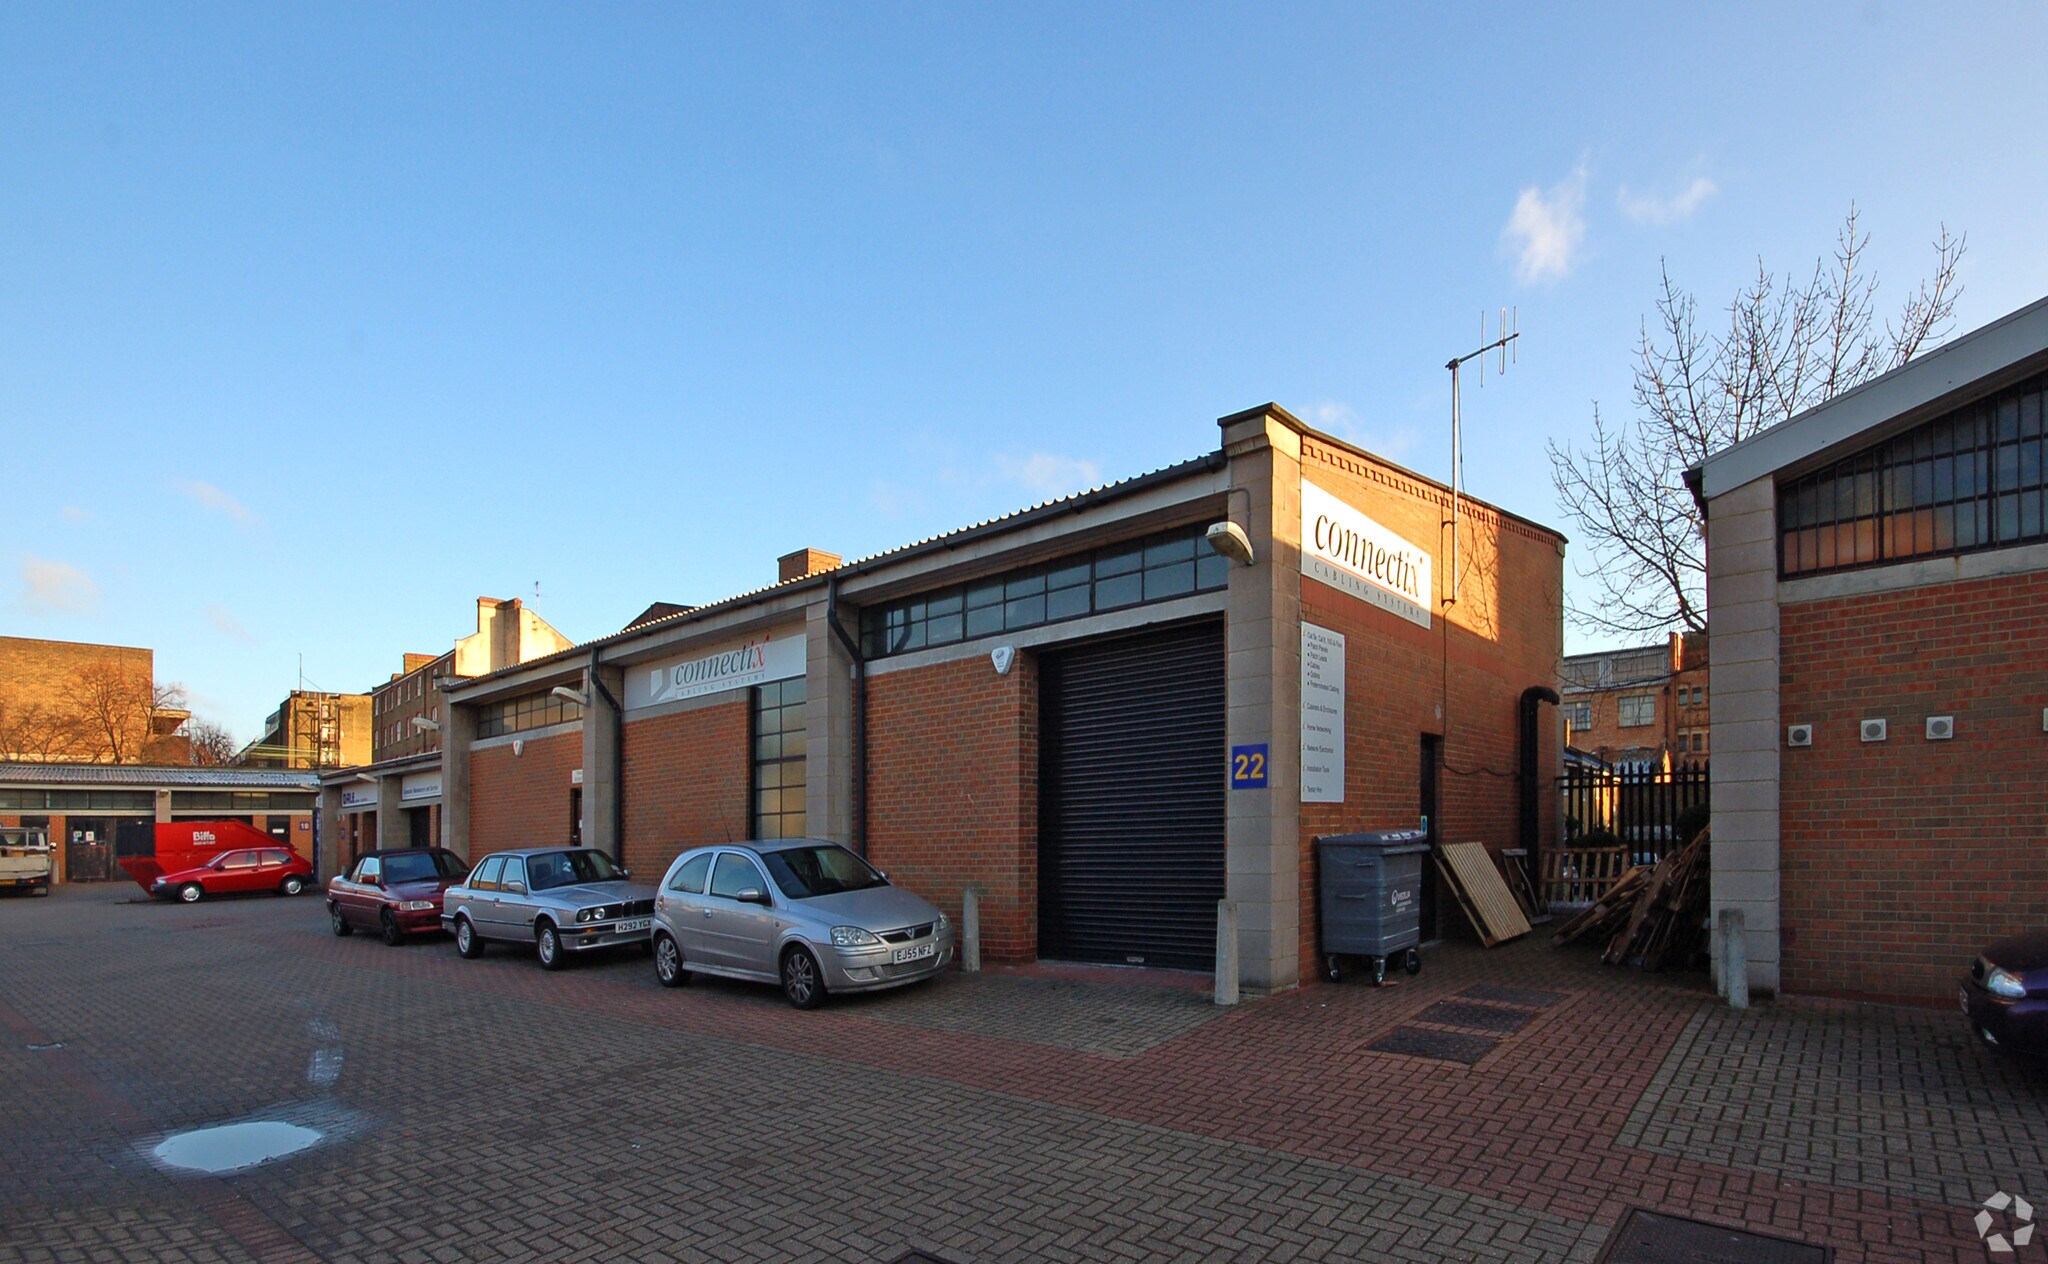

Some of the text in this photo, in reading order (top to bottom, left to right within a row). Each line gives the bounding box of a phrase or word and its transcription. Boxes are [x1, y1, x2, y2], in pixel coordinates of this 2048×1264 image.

[1315, 515, 1423, 598] connectix
[1314, 562, 1420, 618] CABLING SYSTEMS
[675, 633, 770, 686] connectix
[1235, 753, 1265, 780] 22
[618, 921, 637, 931] H292
[896, 944, 932, 961] EJ55 NFZ
